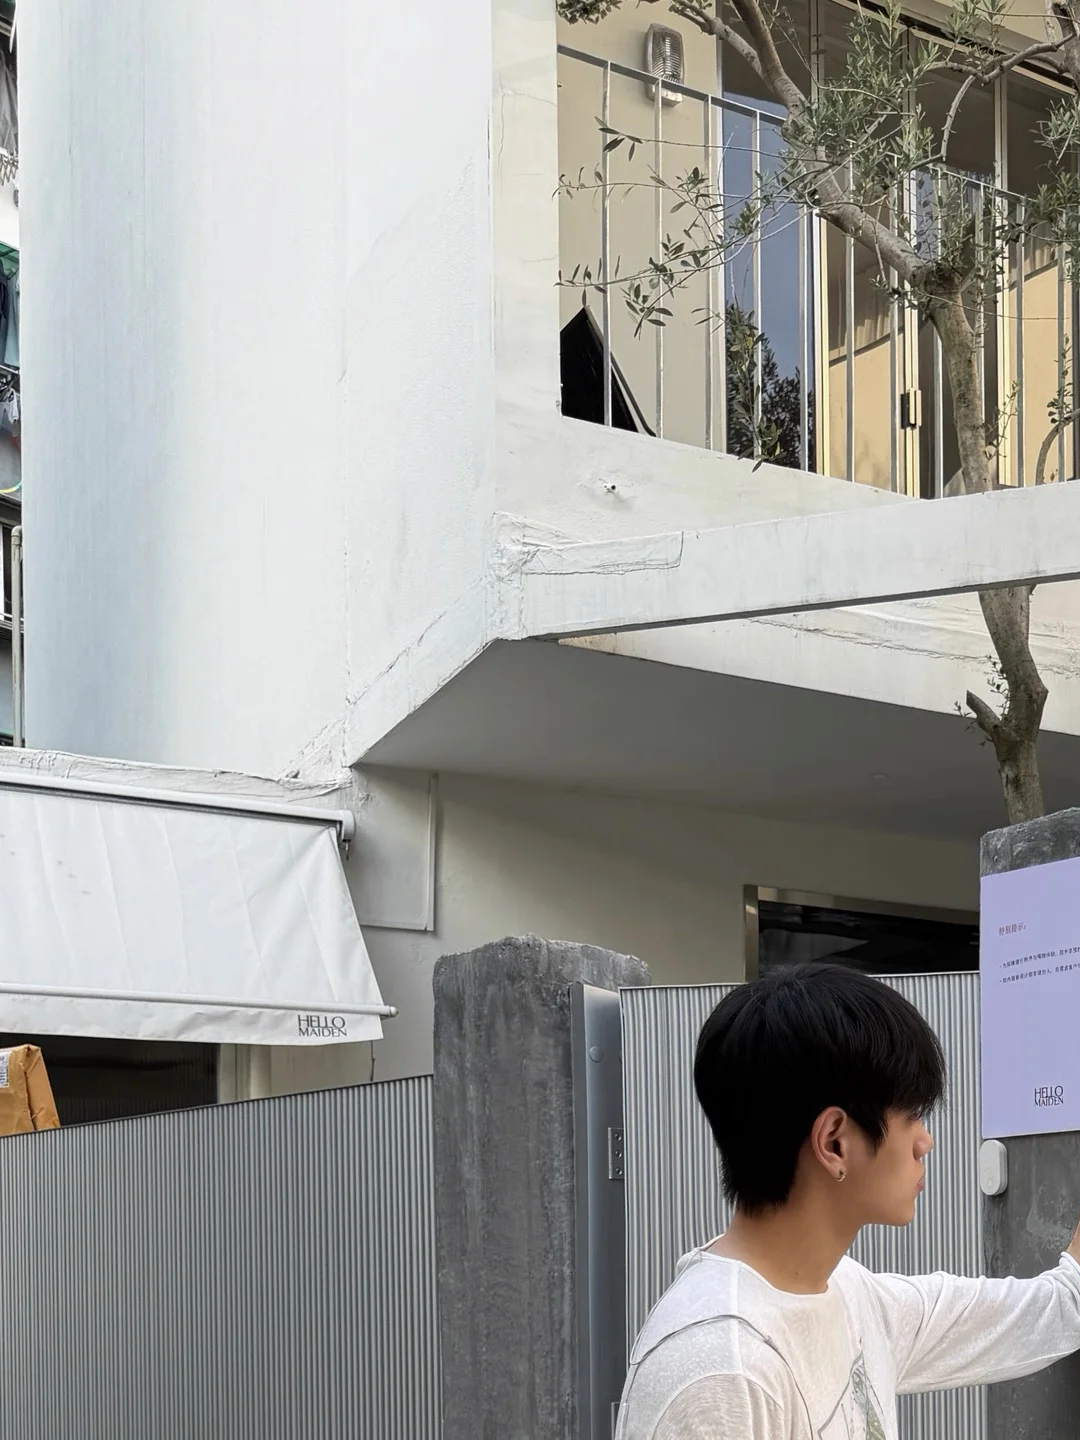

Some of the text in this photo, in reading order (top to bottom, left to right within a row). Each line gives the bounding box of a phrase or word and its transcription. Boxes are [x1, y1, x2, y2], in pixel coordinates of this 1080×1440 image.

[298, 1014, 346, 1028] HELLO
[298, 1027, 347, 1037] MAIDEN
[1034, 1085, 1064, 1099] HELLO
